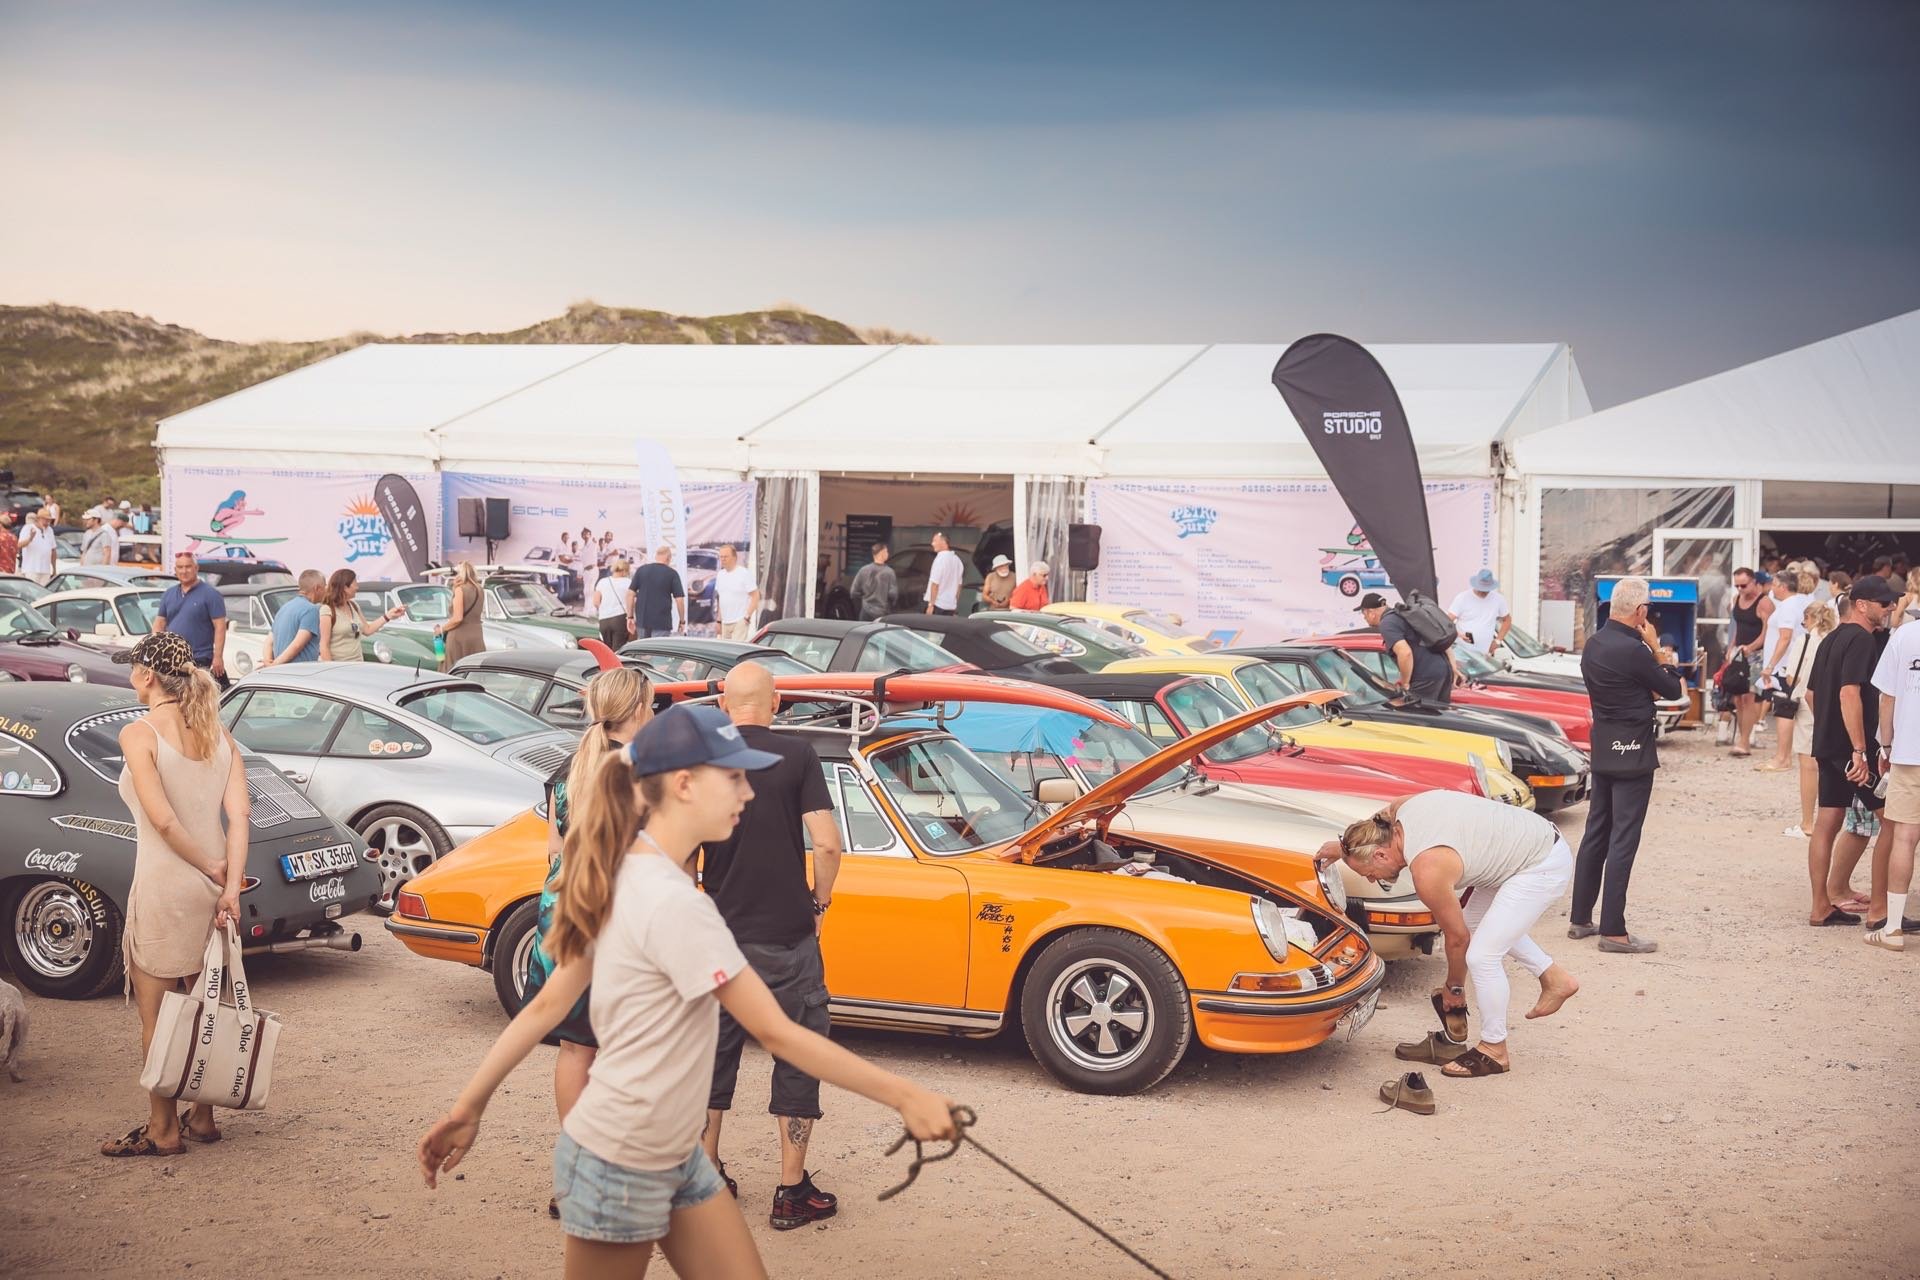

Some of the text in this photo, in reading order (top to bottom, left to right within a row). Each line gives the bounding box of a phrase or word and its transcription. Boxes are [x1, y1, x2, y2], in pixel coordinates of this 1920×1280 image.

[1324, 418, 1382, 434] STUDIO
[1169, 505, 1219, 524] PETRO
[1177, 519, 1213, 539] Surf
[344, 534, 389, 562] Surf
[1611, 739, 1641, 756] Rapha
[289, 845, 355, 874] WT SK 356H
[207, 967, 220, 999] Chloé
[234, 981, 249, 1012] Chloé
[201, 1013, 215, 1045] Chloé
[239, 1023, 253, 1053] Chloé
[190, 1059, 206, 1090] Chloé
[231, 1066, 246, 1098] Chloé
